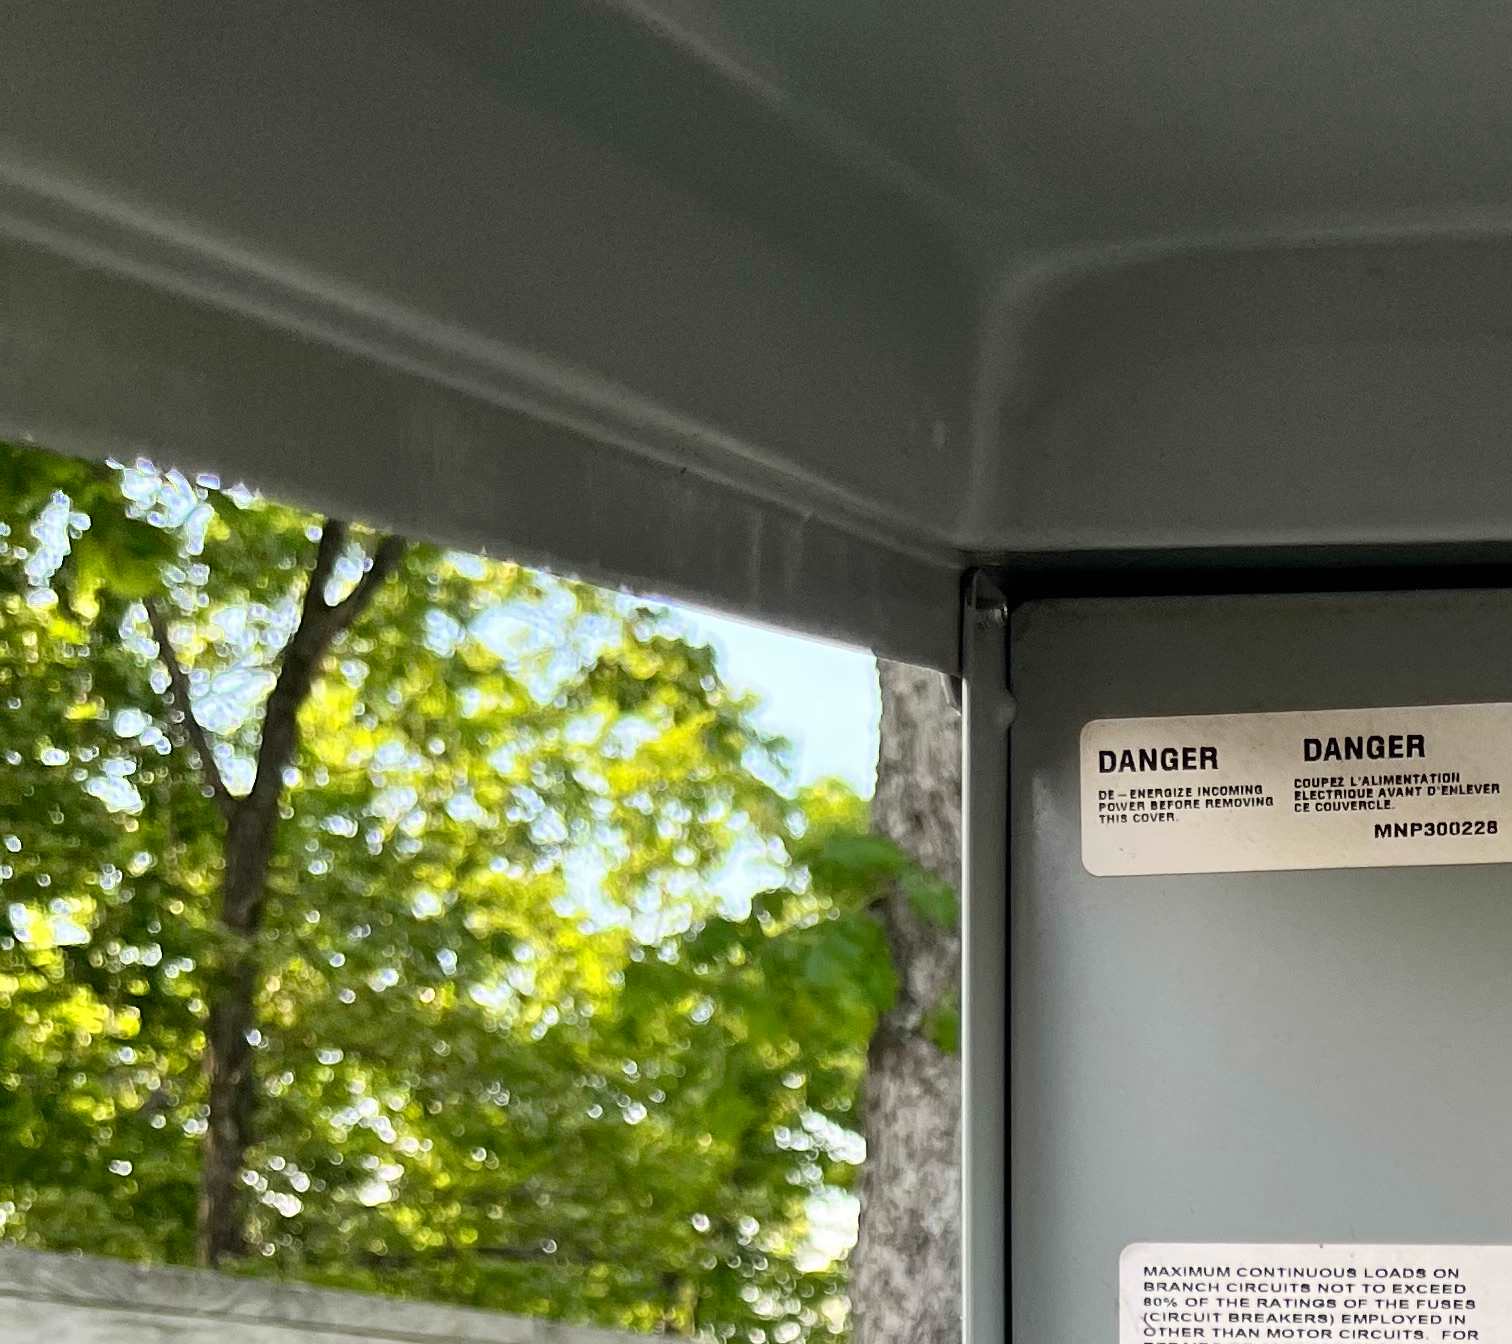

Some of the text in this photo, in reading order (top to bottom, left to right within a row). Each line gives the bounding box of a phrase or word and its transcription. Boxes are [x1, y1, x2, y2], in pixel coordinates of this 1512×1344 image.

[1304, 735, 1425, 761] DANGER
[1099, 747, 1218, 773] DANGER
[1294, 777, 1344, 788] COUPEZ
[1198, 785, 1262, 796] INCOMING
[1378, 787, 1421, 798] AVANT
[1099, 797, 1273, 812] POWER BEFORE REMOVING
[1294, 803, 1309, 812] CE
[1099, 814, 1127, 823] THIS
[1374, 821, 1498, 838] MNP300228
[1143, 1267, 1459, 1278] MAXIMUM CONTINUOUS LOADS ON
[1143, 1282, 1466, 1294] BRANCH CIRCUITS NOT TO EXCEED
[1143, 1297, 1476, 1309] 80% OF THE RATINGS OF THE FUSES
[1143, 1312, 1465, 1326] (CIRCUIT BREAKERS) EMPLOYED IN
[1143, 1328, 1205, 1338] OTHER
[1212, 1328, 1260, 1338] THAN
[1267, 1329, 1332, 1338] MOTOR
[1443, 1330, 1479, 1340] FOR
